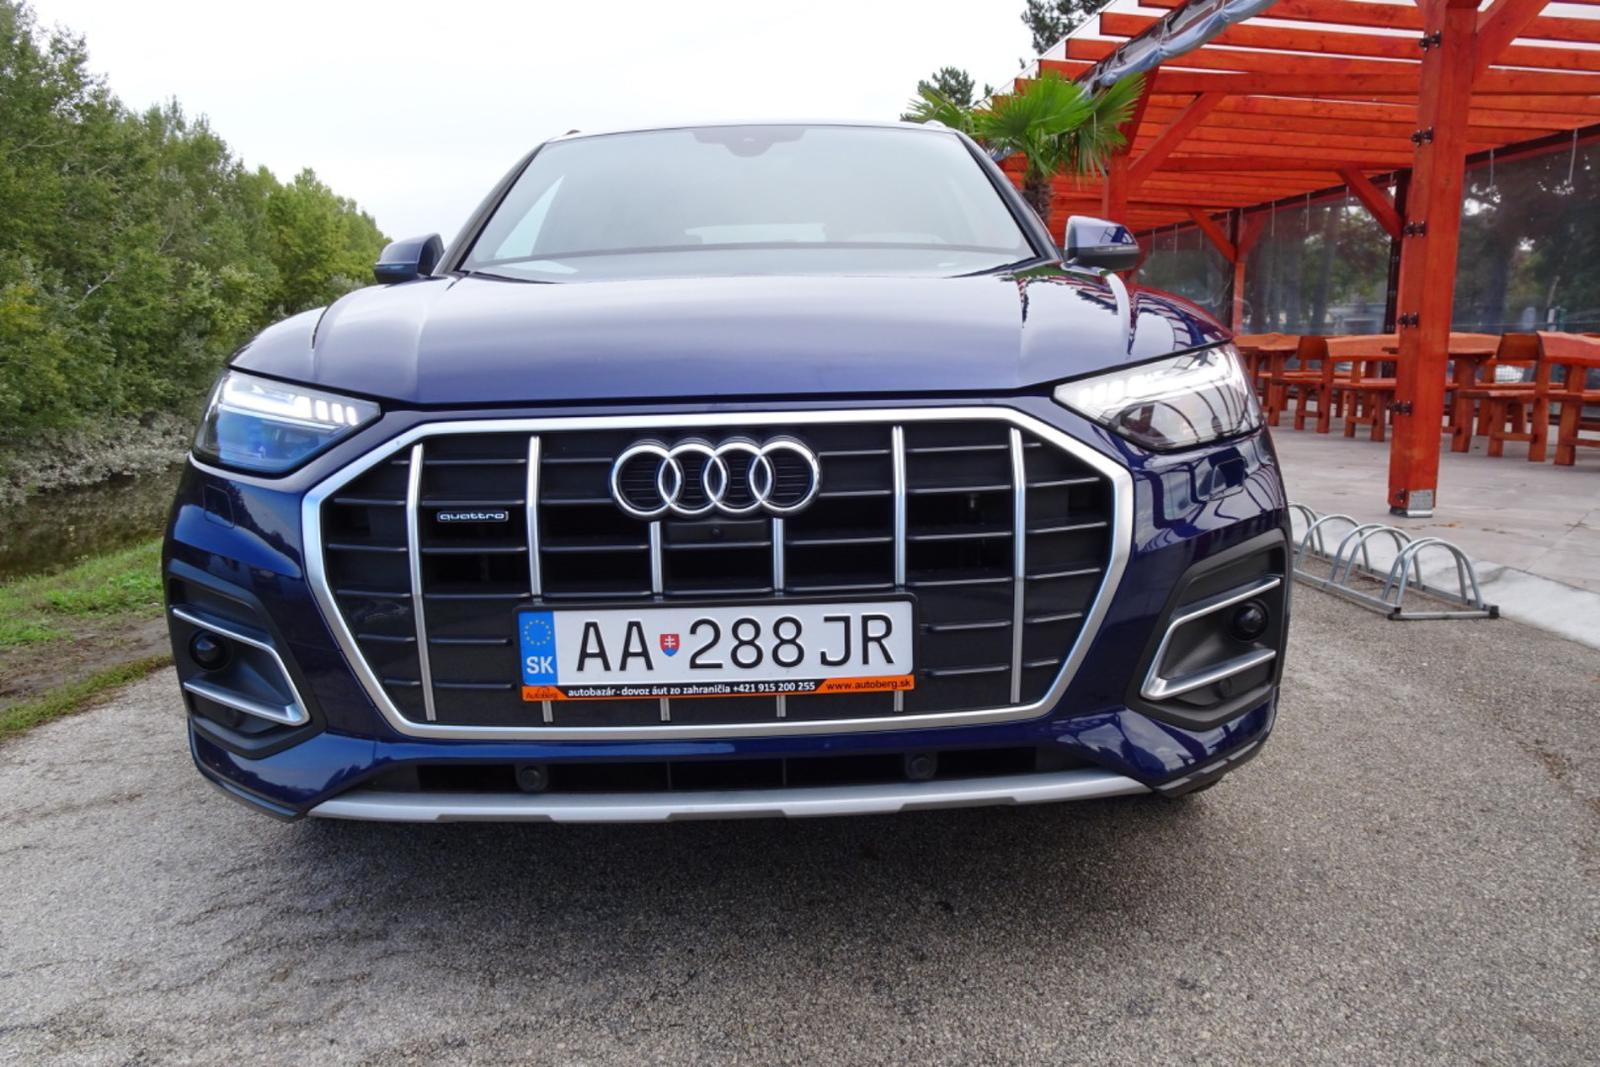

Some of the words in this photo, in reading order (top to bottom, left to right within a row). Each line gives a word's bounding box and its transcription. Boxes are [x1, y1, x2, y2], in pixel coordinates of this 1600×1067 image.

[576, 621, 654, 672] AA
[689, 616, 805, 670] 288
[820, 614, 894, 667] JR
[526, 656, 554, 675] SK
[568, 686, 616, 697] autobazár
[621, 686, 650, 696] dovoz
[652, 685, 668, 695] áut
[670, 687, 681, 695] zo
[683, 684, 730, 694] zahraničia
[733, 683, 756, 693] +421
[758, 682, 775, 692] 915
[778, 682, 796, 692] 200
[798, 681, 815, 691] 255
[826, 678, 911, 691] www.autoberg.sk
